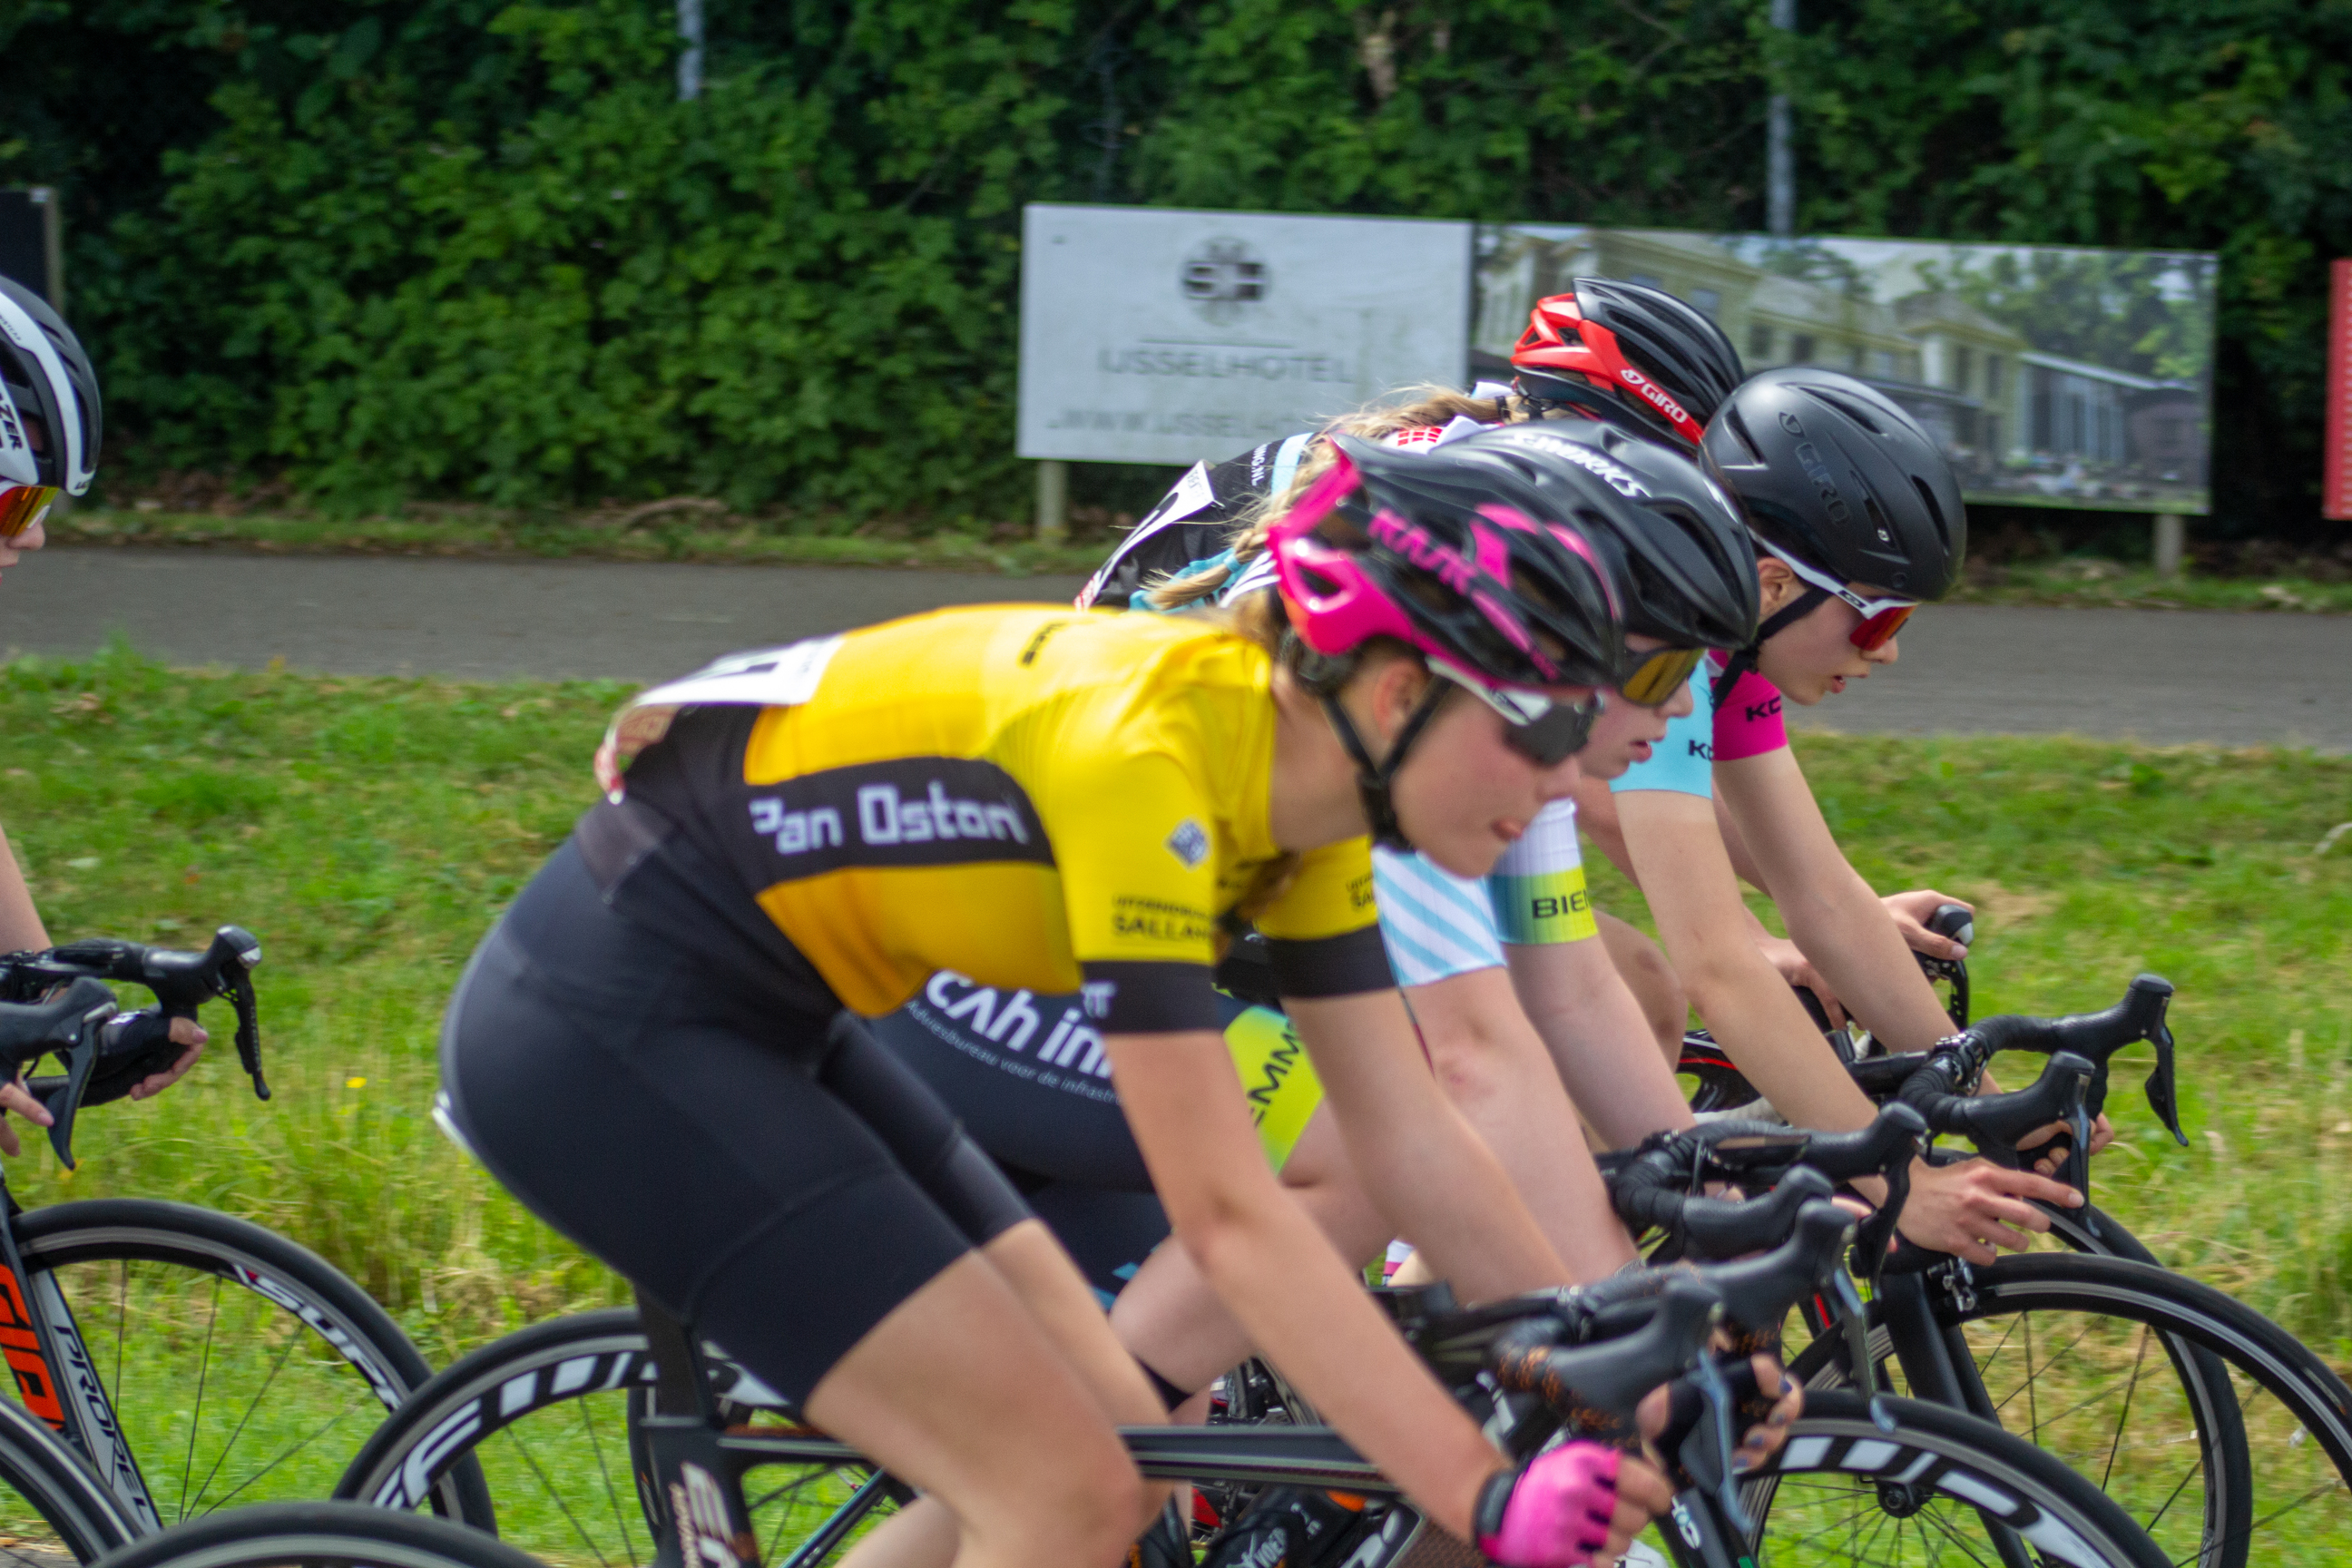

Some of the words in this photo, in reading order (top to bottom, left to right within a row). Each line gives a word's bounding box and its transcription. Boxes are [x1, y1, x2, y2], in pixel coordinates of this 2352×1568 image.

[1641, 382, 1689, 424] GIRO
[1794, 441, 1850, 526] GIRO
[857, 779, 1030, 845] Oston
[1000, 1057, 1039, 1081] voor
[1037, 1071, 1061, 1089] de
[54, 1325, 149, 1524] PROPEL
